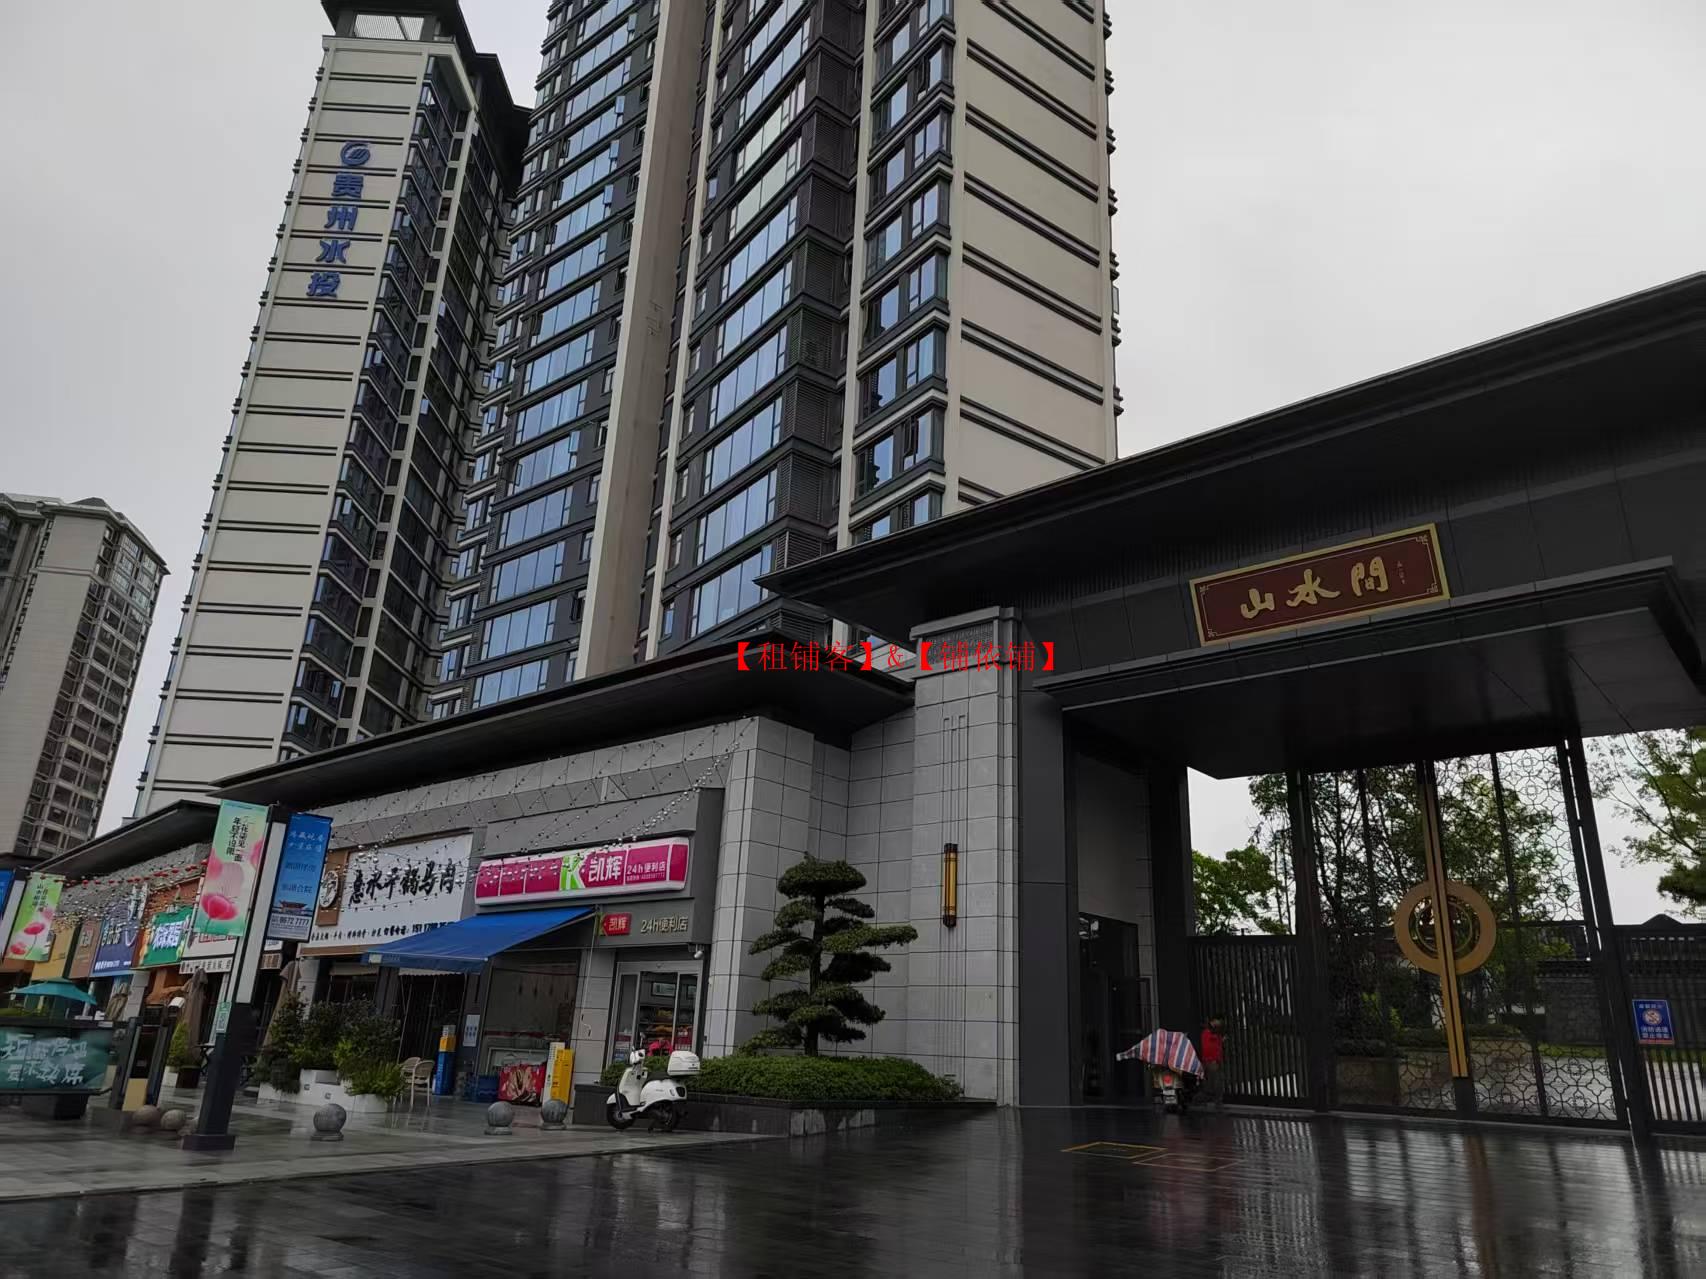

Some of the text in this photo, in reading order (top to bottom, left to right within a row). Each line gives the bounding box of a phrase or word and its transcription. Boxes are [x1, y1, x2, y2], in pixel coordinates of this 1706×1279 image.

[306, 171, 365, 298] 贵州水投
[588, 855, 624, 883] 凯辉
[626, 860, 666, 875] 24h便利店
[608, 916, 629, 932] 凯辉
[640, 915, 689, 935] 24h便利店
